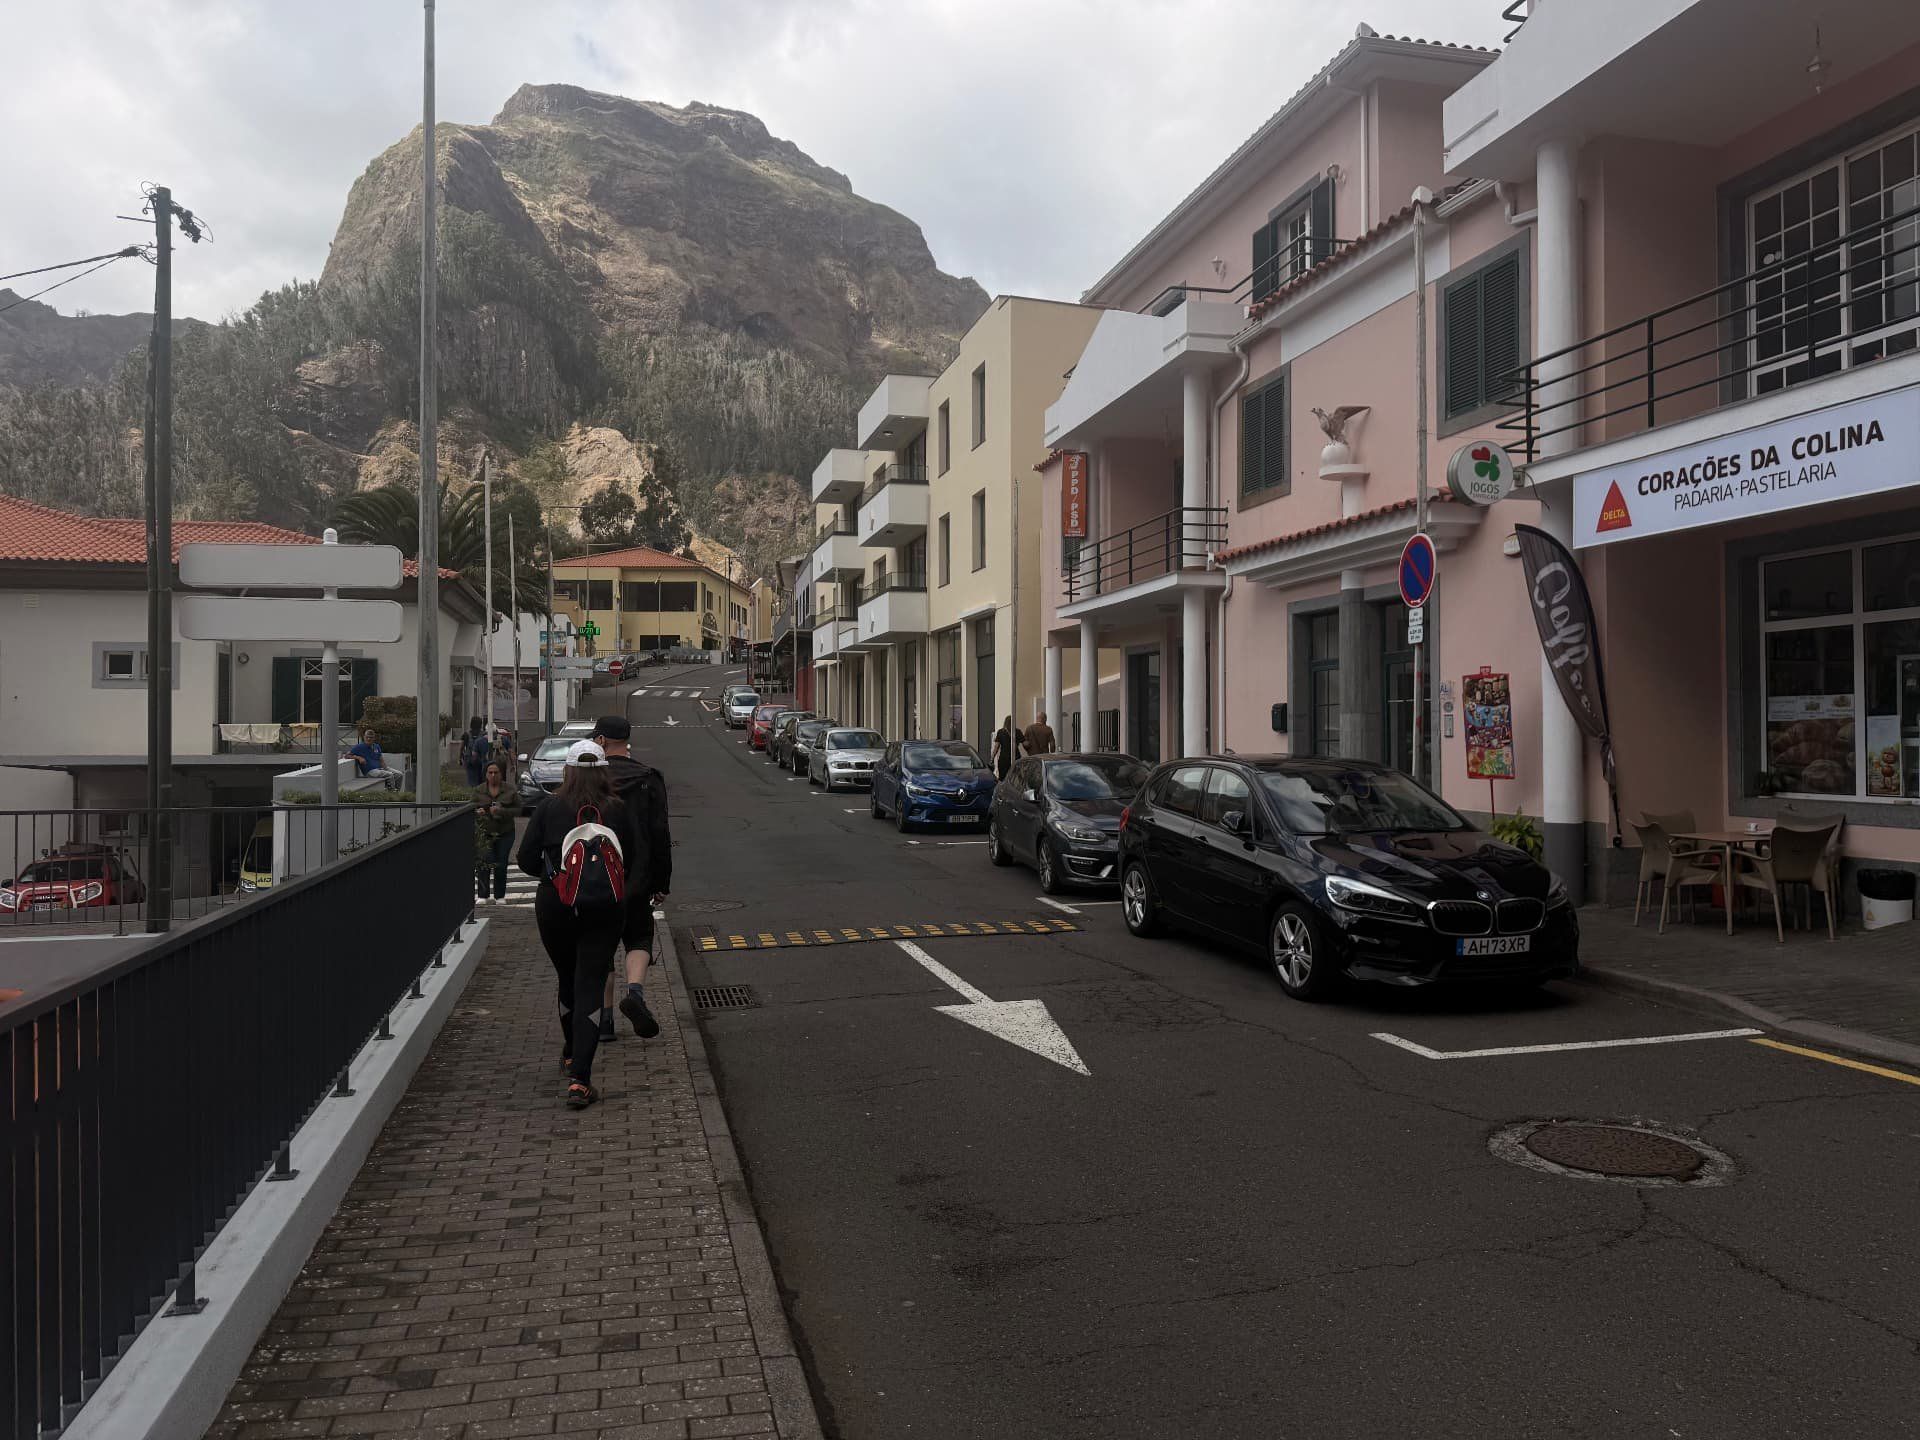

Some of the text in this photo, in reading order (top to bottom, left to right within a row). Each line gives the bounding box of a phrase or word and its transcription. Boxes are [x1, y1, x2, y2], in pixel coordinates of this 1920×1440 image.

[1638, 420, 1884, 496] CORAÇÕES DA COLINA
[1469, 481, 1500, 495] JOGOS
[1603, 508, 1625, 520] DELTA
